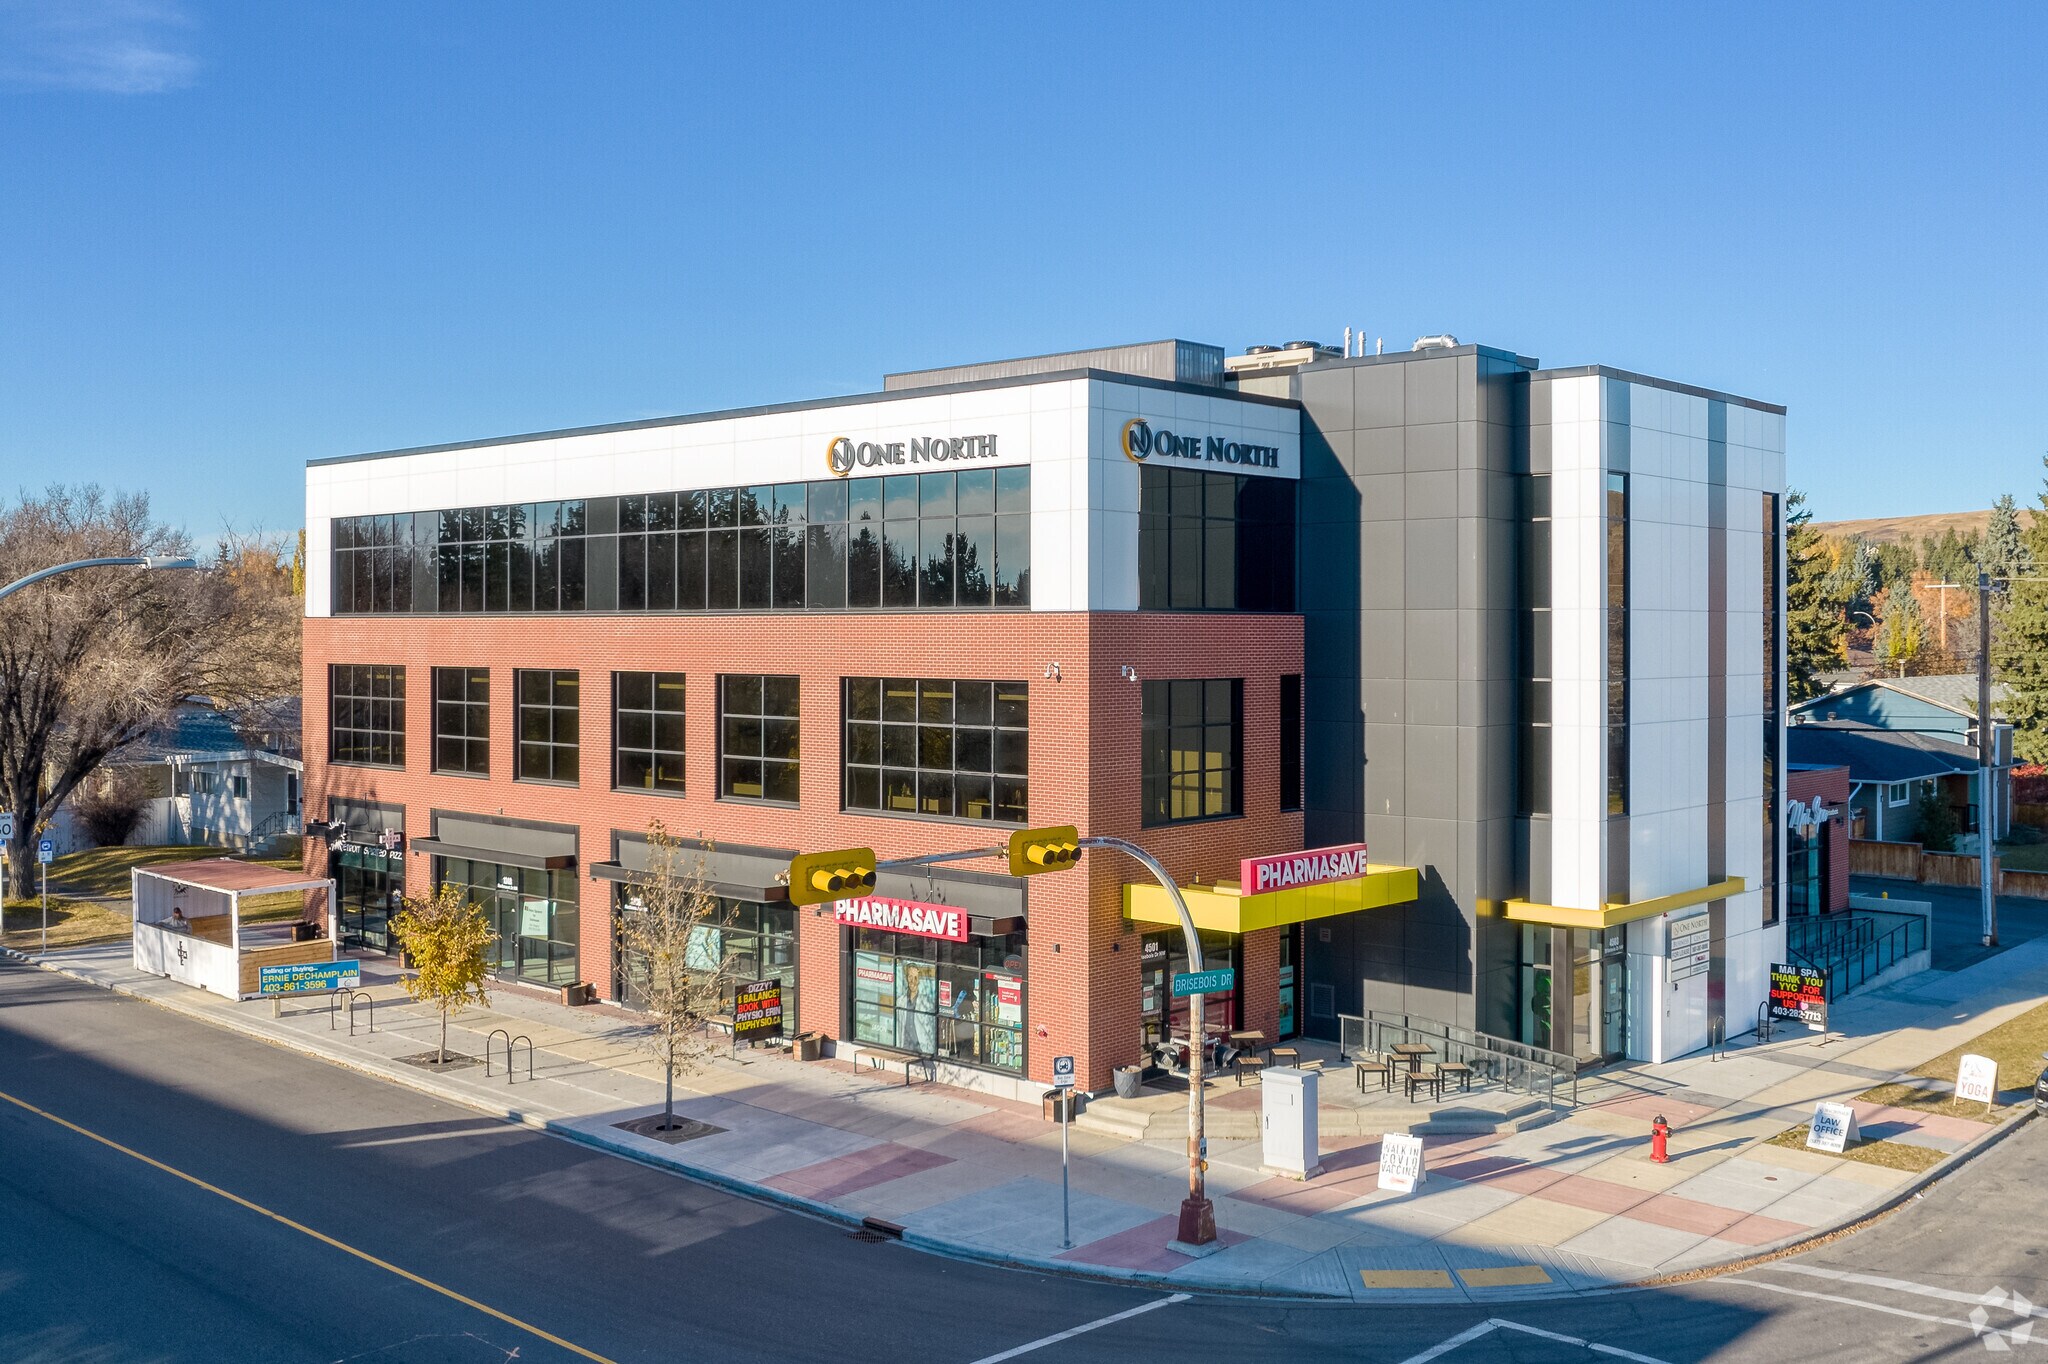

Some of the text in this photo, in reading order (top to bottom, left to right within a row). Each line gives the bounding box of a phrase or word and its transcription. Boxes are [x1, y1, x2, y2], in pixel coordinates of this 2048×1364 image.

[856, 441, 906, 467] ONE
[910, 434, 998, 464] NORTH
[1154, 430, 1202, 459] ONE
[1205, 435, 1280, 468] NORTH
[0, 823, 11, 835] 0
[1256, 849, 1367, 890] PHARMASAVE
[835, 899, 959, 937] PHARMASAVE
[1144, 942, 1159, 953] 4501
[262, 967, 284, 975] Selling
[262, 969, 358, 983] ERNIE DECHAMPLAIN
[1779, 965, 1819, 978] MAI SPA
[263, 980, 327, 992] 403-861-3596
[748, 981, 773, 993] DIZZY?
[1175, 973, 1232, 992] BRISEBOIS DR
[1771, 972, 1823, 988] THANK YOU
[743, 988, 780, 1001] BALANCE?
[1779, 982, 1820, 995] YYC FOR
[1771, 989, 1825, 1006] SUPPORTING
[1783, 999, 1797, 1008] US!
[738, 998, 779, 1013] BOOK WITH
[737, 1006, 781, 1022] PHYSIO ERIN
[735, 1016, 781, 1032] FIXPHYSIO.CA
[1961, 1081, 1988, 1098] YOGA
[1820, 1116, 1841, 1127] LAW
[1813, 1124, 1844, 1137] OFFICE
[1384, 1143, 1419, 1157] WALK IN
[1381, 1164, 1417, 1178] VACCINE
